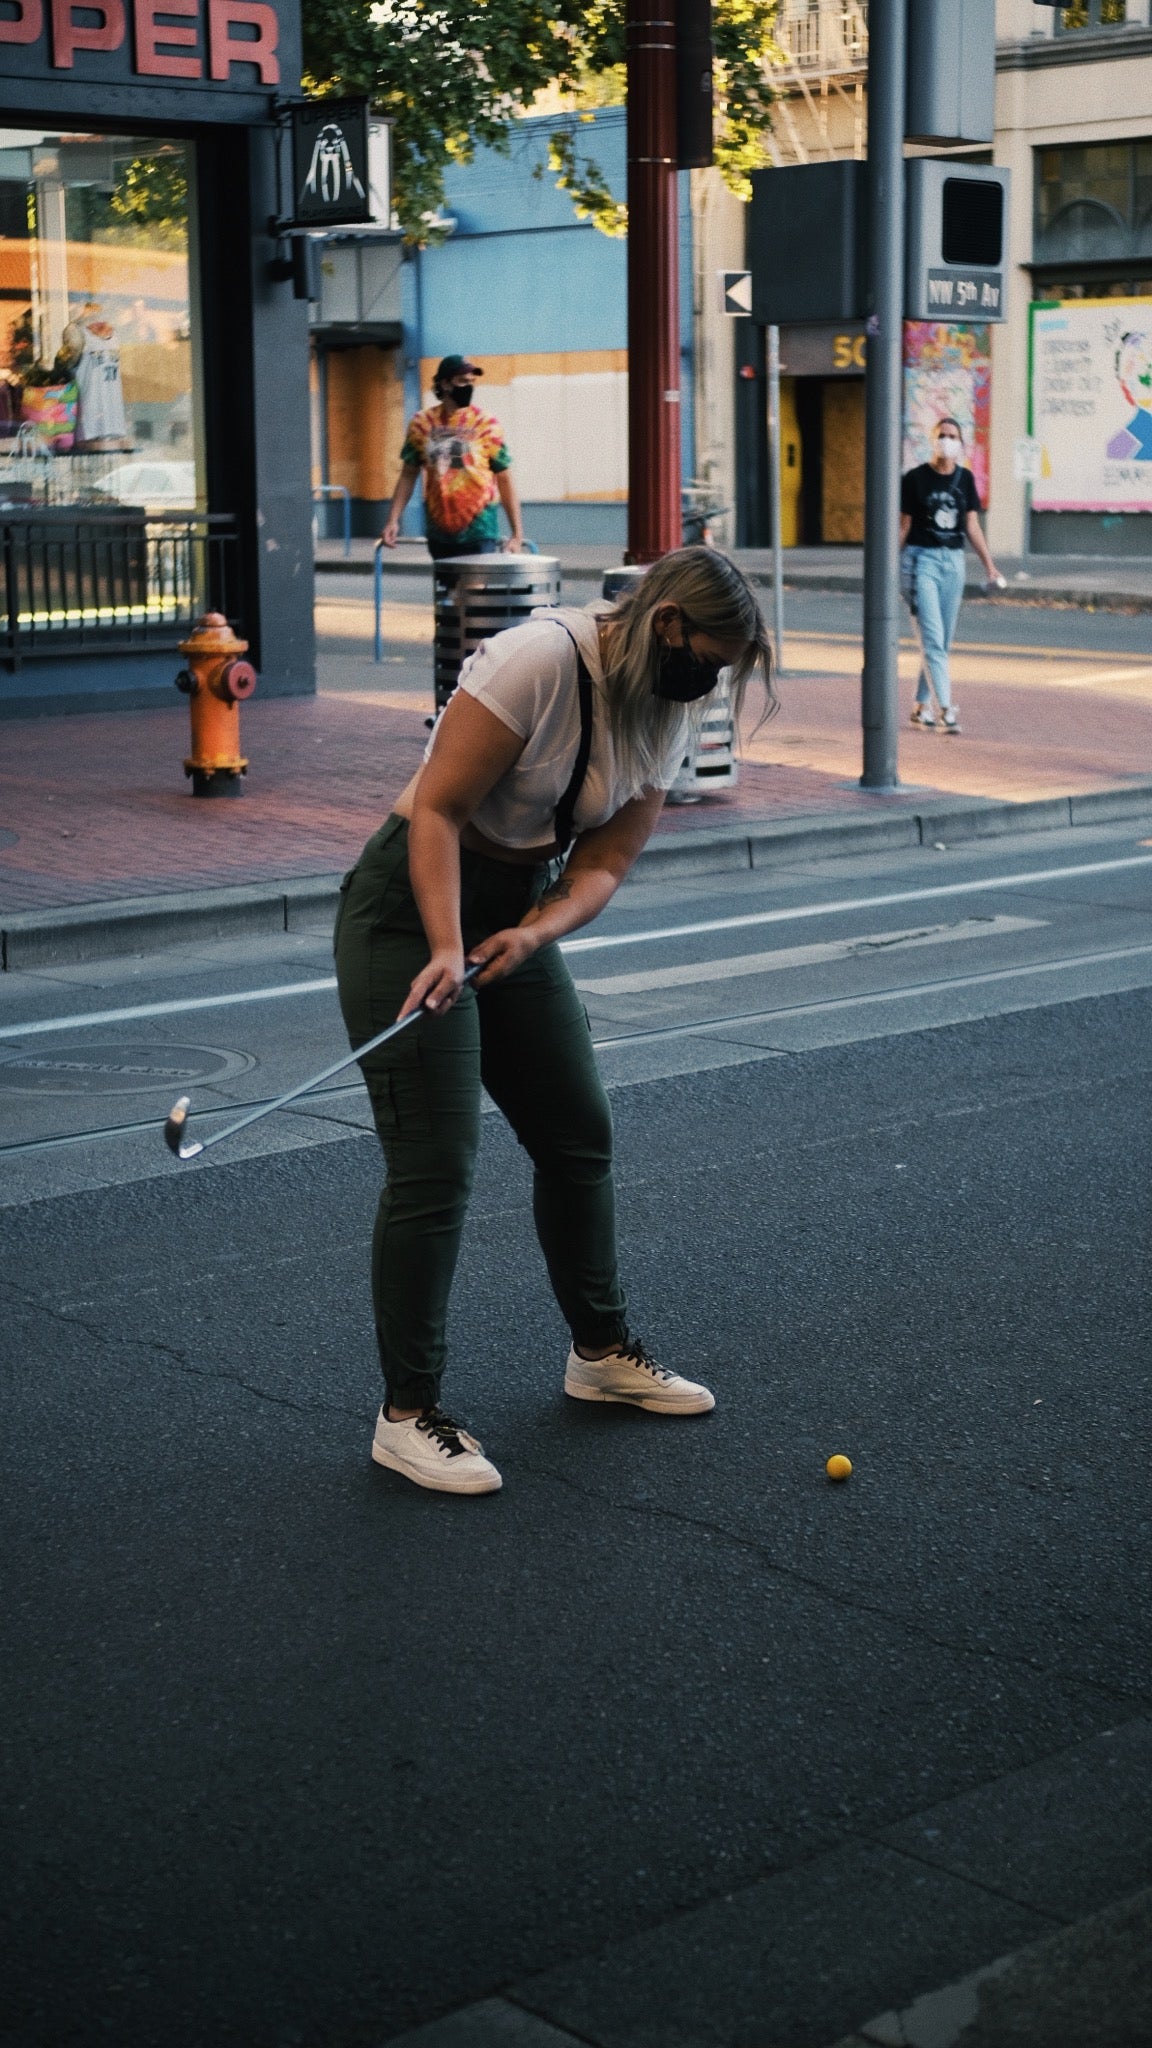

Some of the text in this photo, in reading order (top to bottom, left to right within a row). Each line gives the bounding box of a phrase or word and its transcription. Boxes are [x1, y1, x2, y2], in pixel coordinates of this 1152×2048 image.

[301, 106, 361, 125] UPPER
[928, 279, 954, 305] NW
[956, 281, 978, 306] 5th
